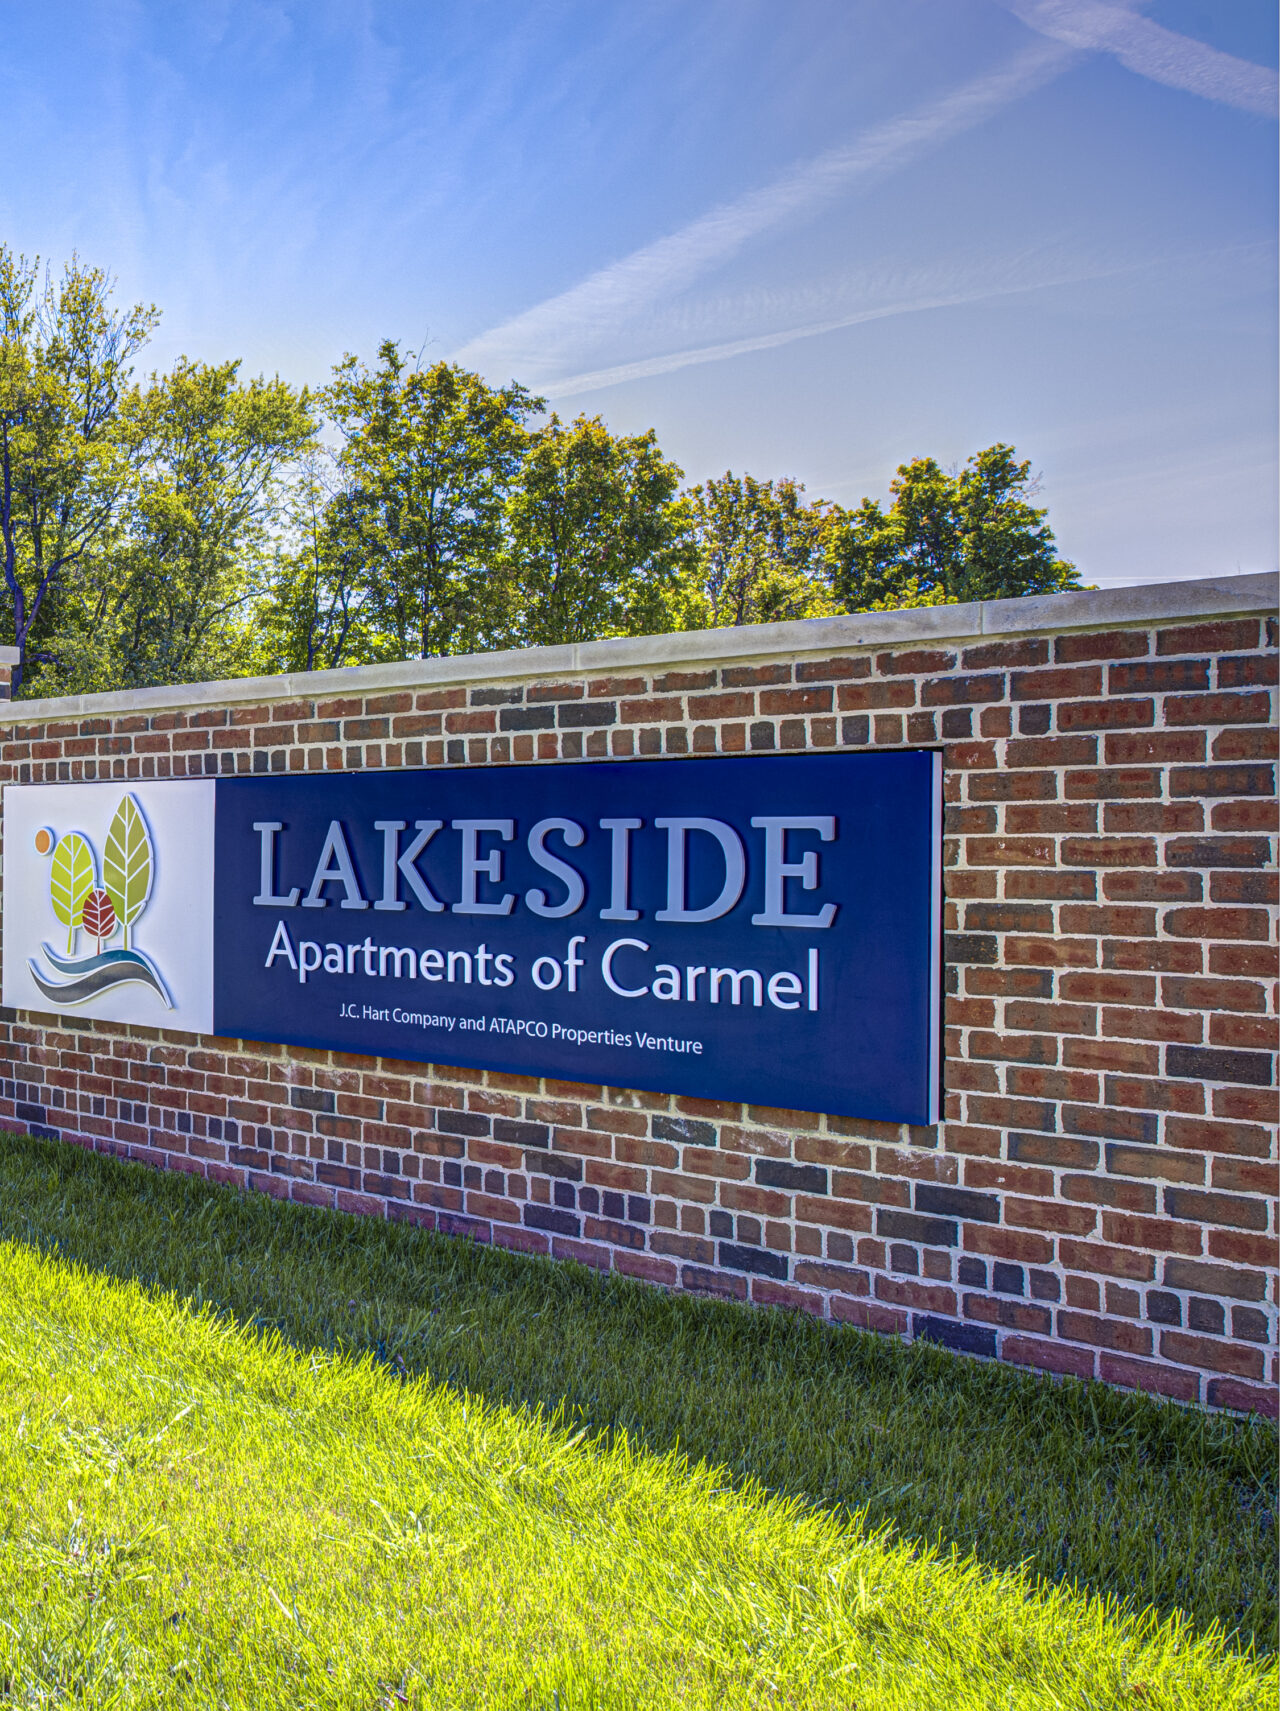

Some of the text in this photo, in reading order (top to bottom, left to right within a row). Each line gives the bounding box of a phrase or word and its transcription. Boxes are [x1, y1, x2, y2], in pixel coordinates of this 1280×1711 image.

[253, 816, 838, 927] LAKESIDE
[265, 920, 818, 1011] Apartments of Carmel
[340, 1003, 703, 1055] J.C. Hart Company and ATAPCO Properties Venture
